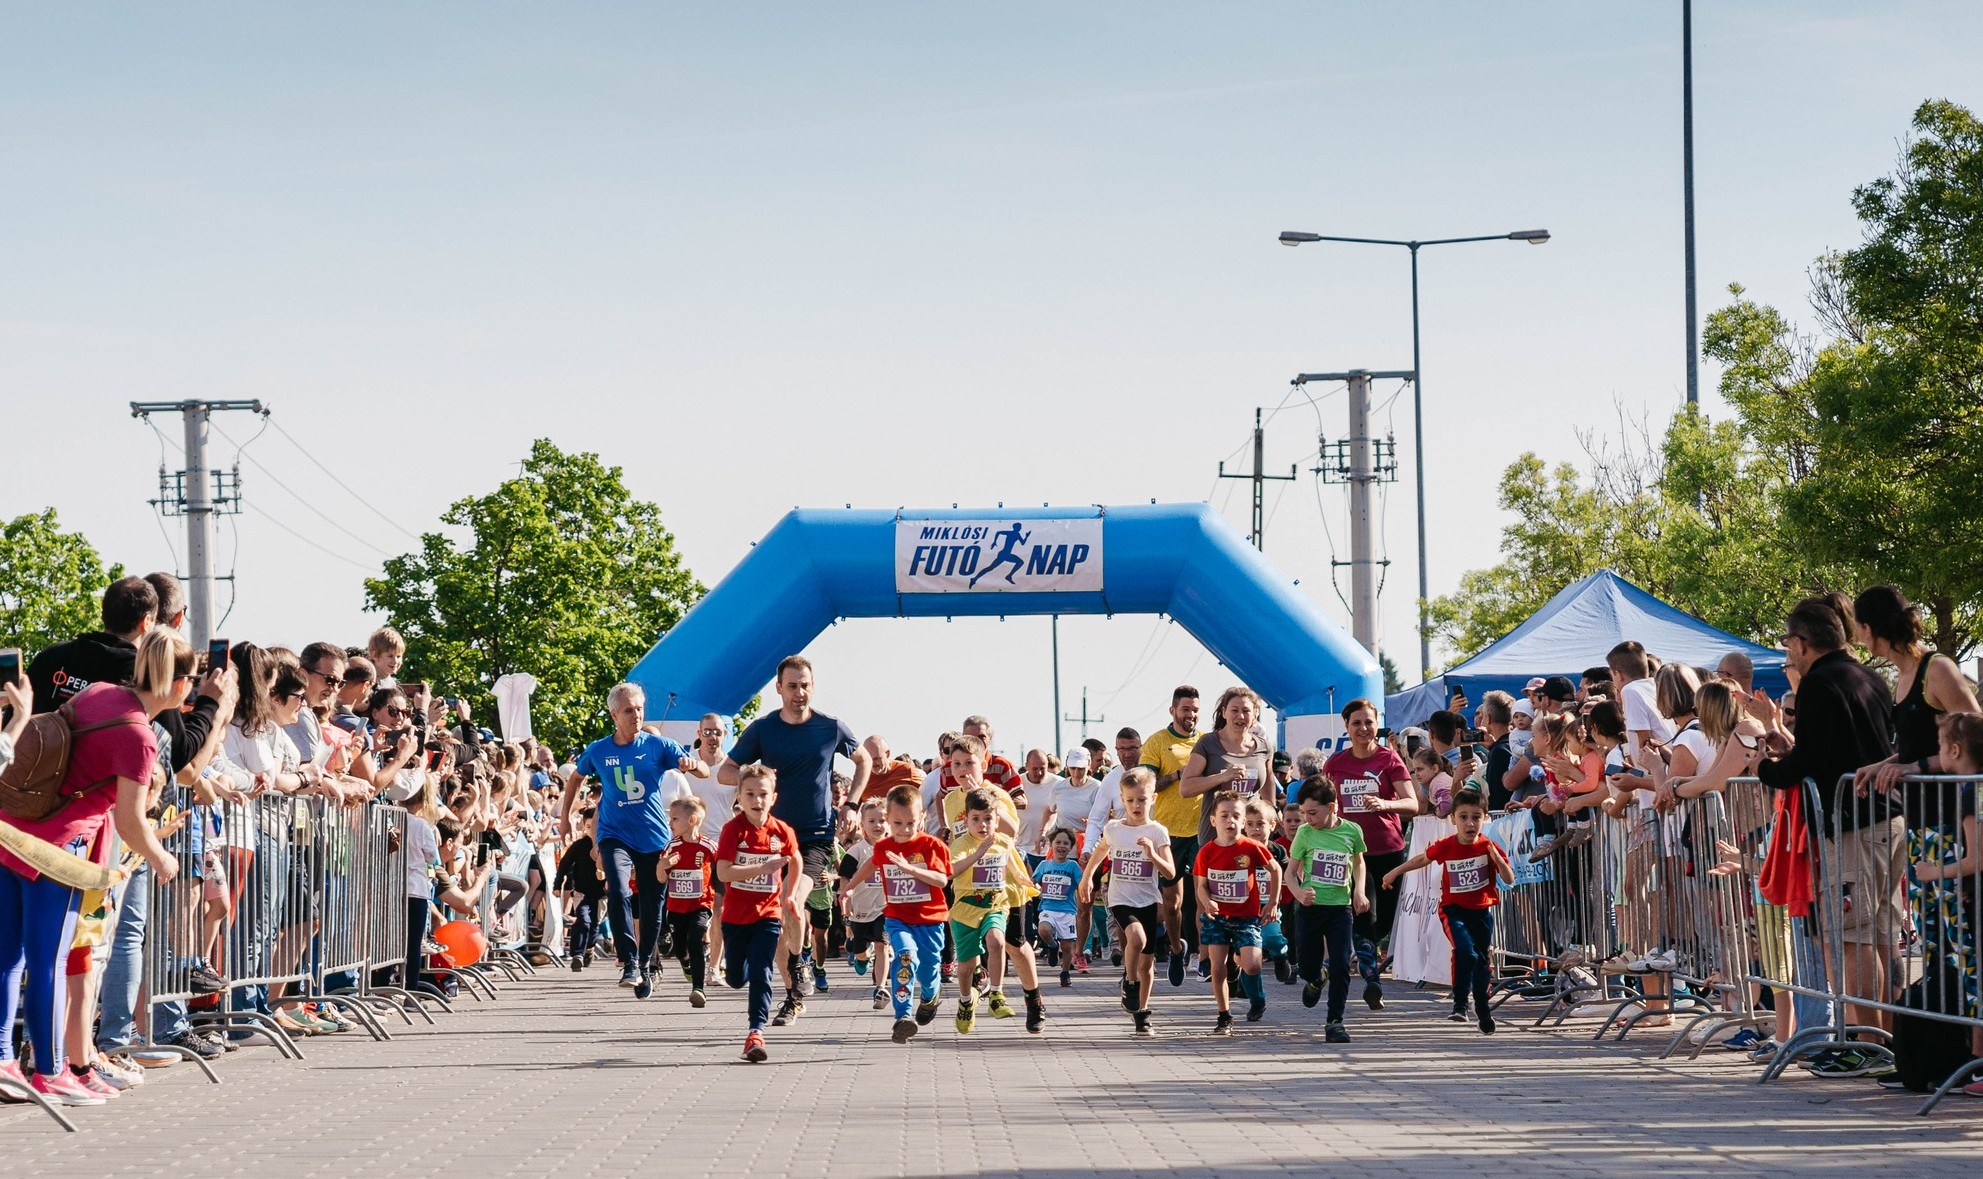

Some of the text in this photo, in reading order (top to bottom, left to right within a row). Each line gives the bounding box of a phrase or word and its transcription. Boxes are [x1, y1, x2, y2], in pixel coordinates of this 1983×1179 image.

[919, 525, 989, 540] MIKLÓSI
[908, 541, 1090, 576] FUTÓ NAP
[605, 758, 620, 766] NN
[1231, 780, 1248, 792] 617
[1351, 794, 1364, 807] 68
[985, 868, 1003, 882] 756
[1121, 860, 1142, 876] 565
[1323, 863, 1345, 880] 518
[1458, 870, 1480, 886] 523
[675, 880, 693, 893] 569
[892, 879, 917, 896] 732
[1046, 883, 1063, 895] 664
[1217, 882, 1236, 897] 551
